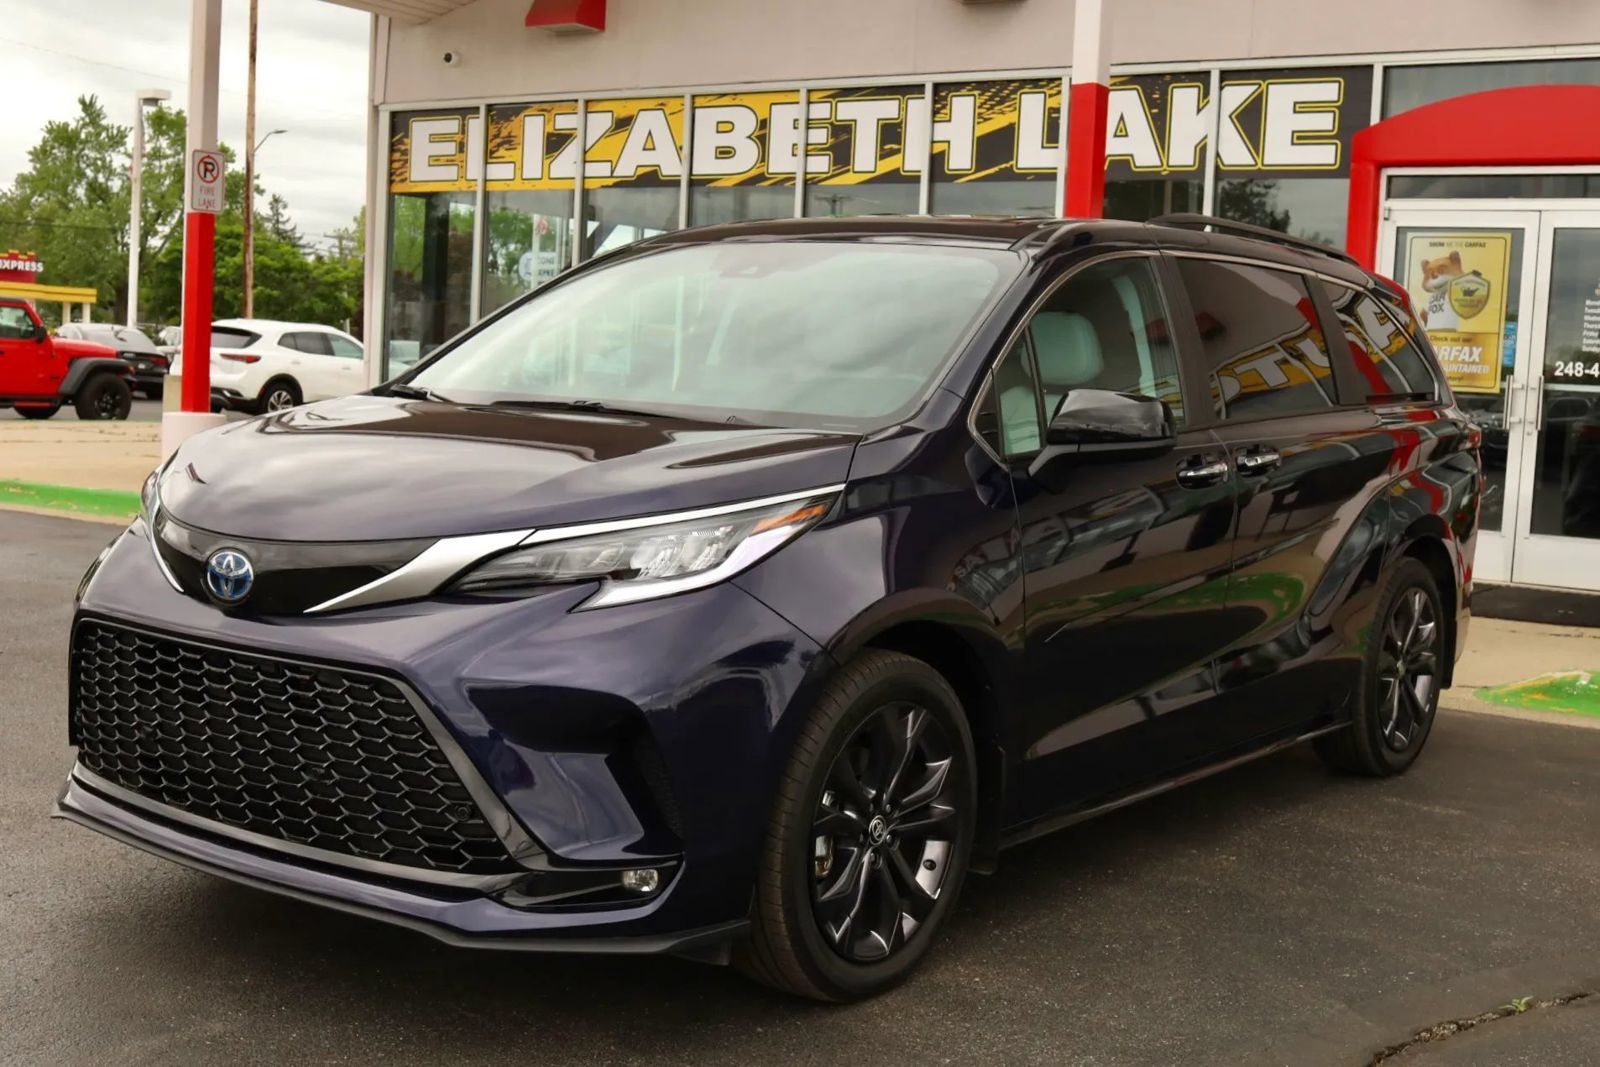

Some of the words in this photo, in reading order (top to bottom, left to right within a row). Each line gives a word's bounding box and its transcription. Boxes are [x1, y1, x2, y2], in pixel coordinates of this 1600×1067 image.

[408, 92, 978, 183] ELIZABETH
[1014, 78, 1344, 172] LAKE
[200, 186, 215, 195] FIRE
[198, 198, 216, 208] LANE
